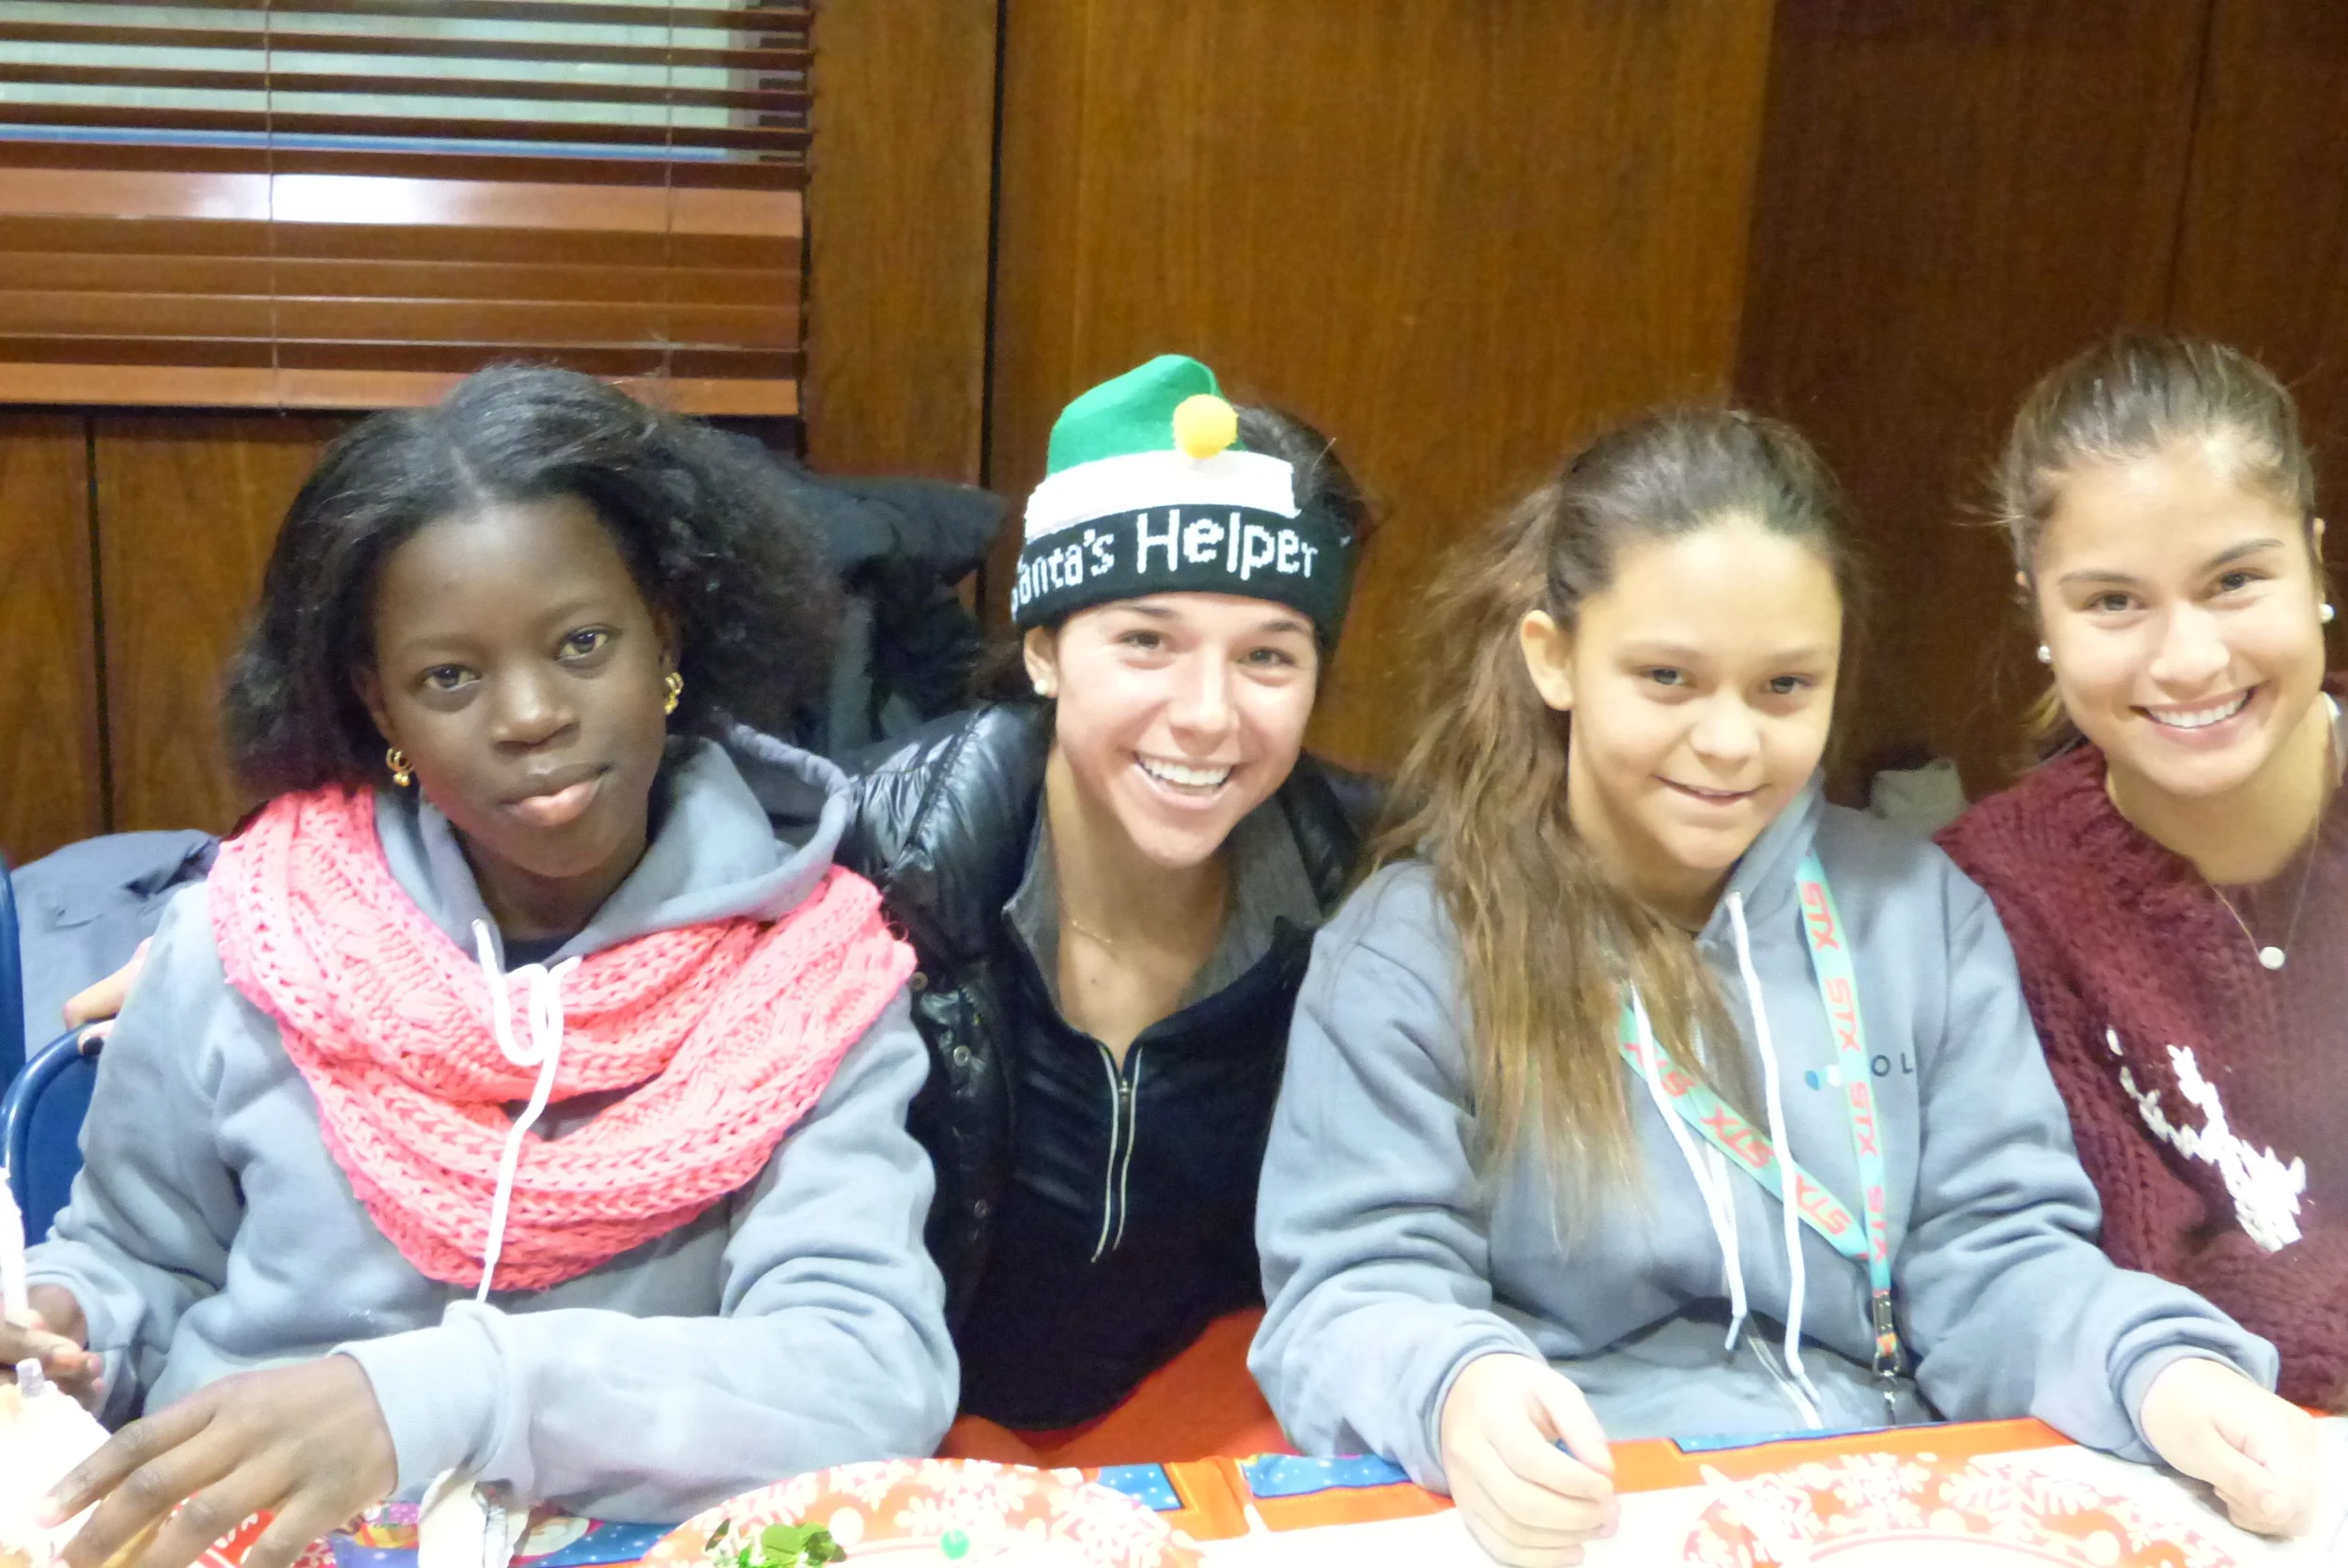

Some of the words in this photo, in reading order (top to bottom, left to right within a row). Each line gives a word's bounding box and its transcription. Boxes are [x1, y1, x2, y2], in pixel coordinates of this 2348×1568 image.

[1136, 509, 1319, 581] Helper
[1800, 882, 1841, 951] STX
[1825, 976, 1861, 1053] STX
[1849, 1081, 1878, 1157] STX
[1700, 1104, 1775, 1168] STX
